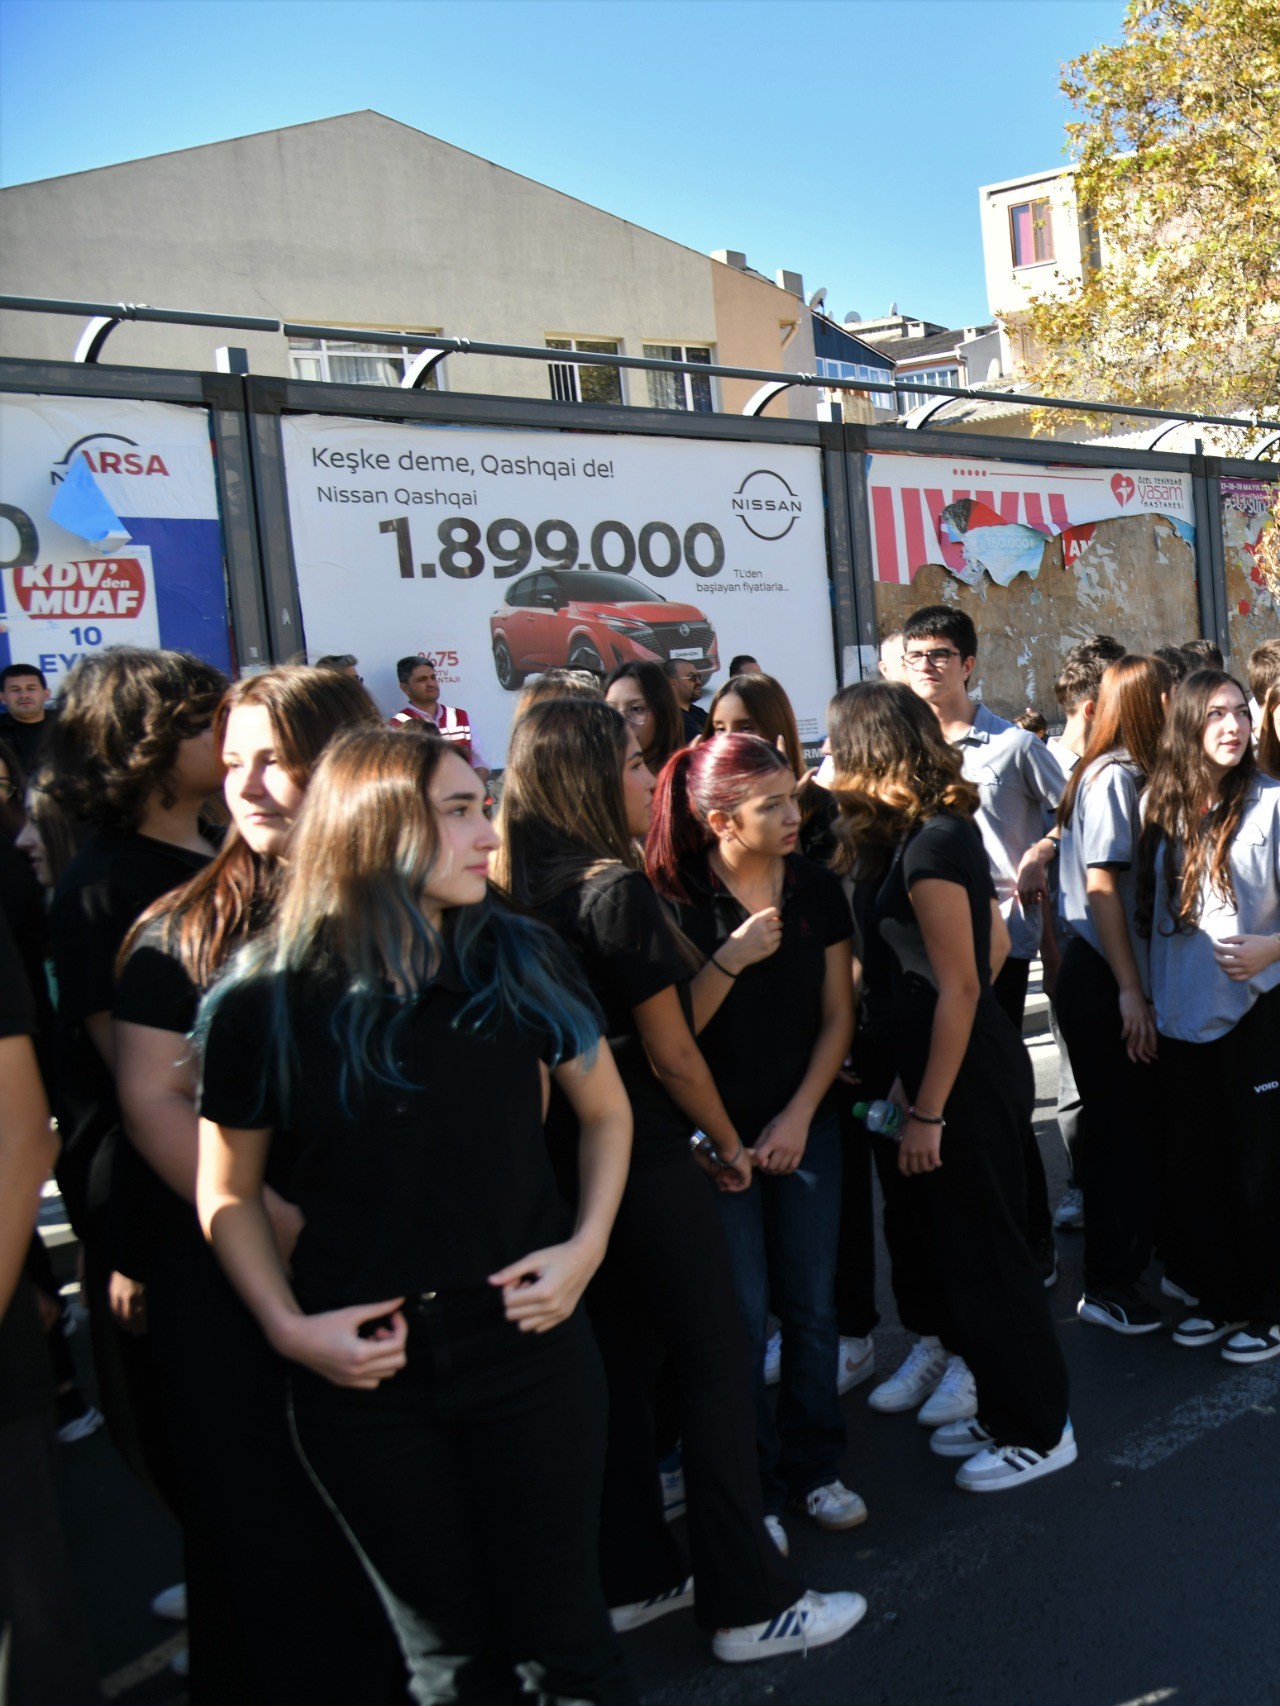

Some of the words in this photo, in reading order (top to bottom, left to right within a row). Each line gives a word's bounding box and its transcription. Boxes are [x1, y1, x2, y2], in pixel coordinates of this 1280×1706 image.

[312, 447, 390, 474] Keşke
[398, 450, 475, 476] deme,
[481, 454, 576, 481] Qashqai
[583, 459, 614, 478] de!
[1138, 476, 1153, 484] ÖZEL
[317, 486, 388, 504] Nissan
[394, 488, 478, 509] Qashqai
[1138, 485, 1183, 504] yaşam
[732, 498, 802, 512] NISSAN
[379, 517, 725, 579] 1.899.000
[733, 569, 763, 579] TL'den
[696, 582, 741, 594] başlayan
[26, 590, 139, 615] MUAF
[70, 626, 103, 646] 10
[418, 651, 459, 667] %75
[1254, 1080, 1279, 1093] VOID
